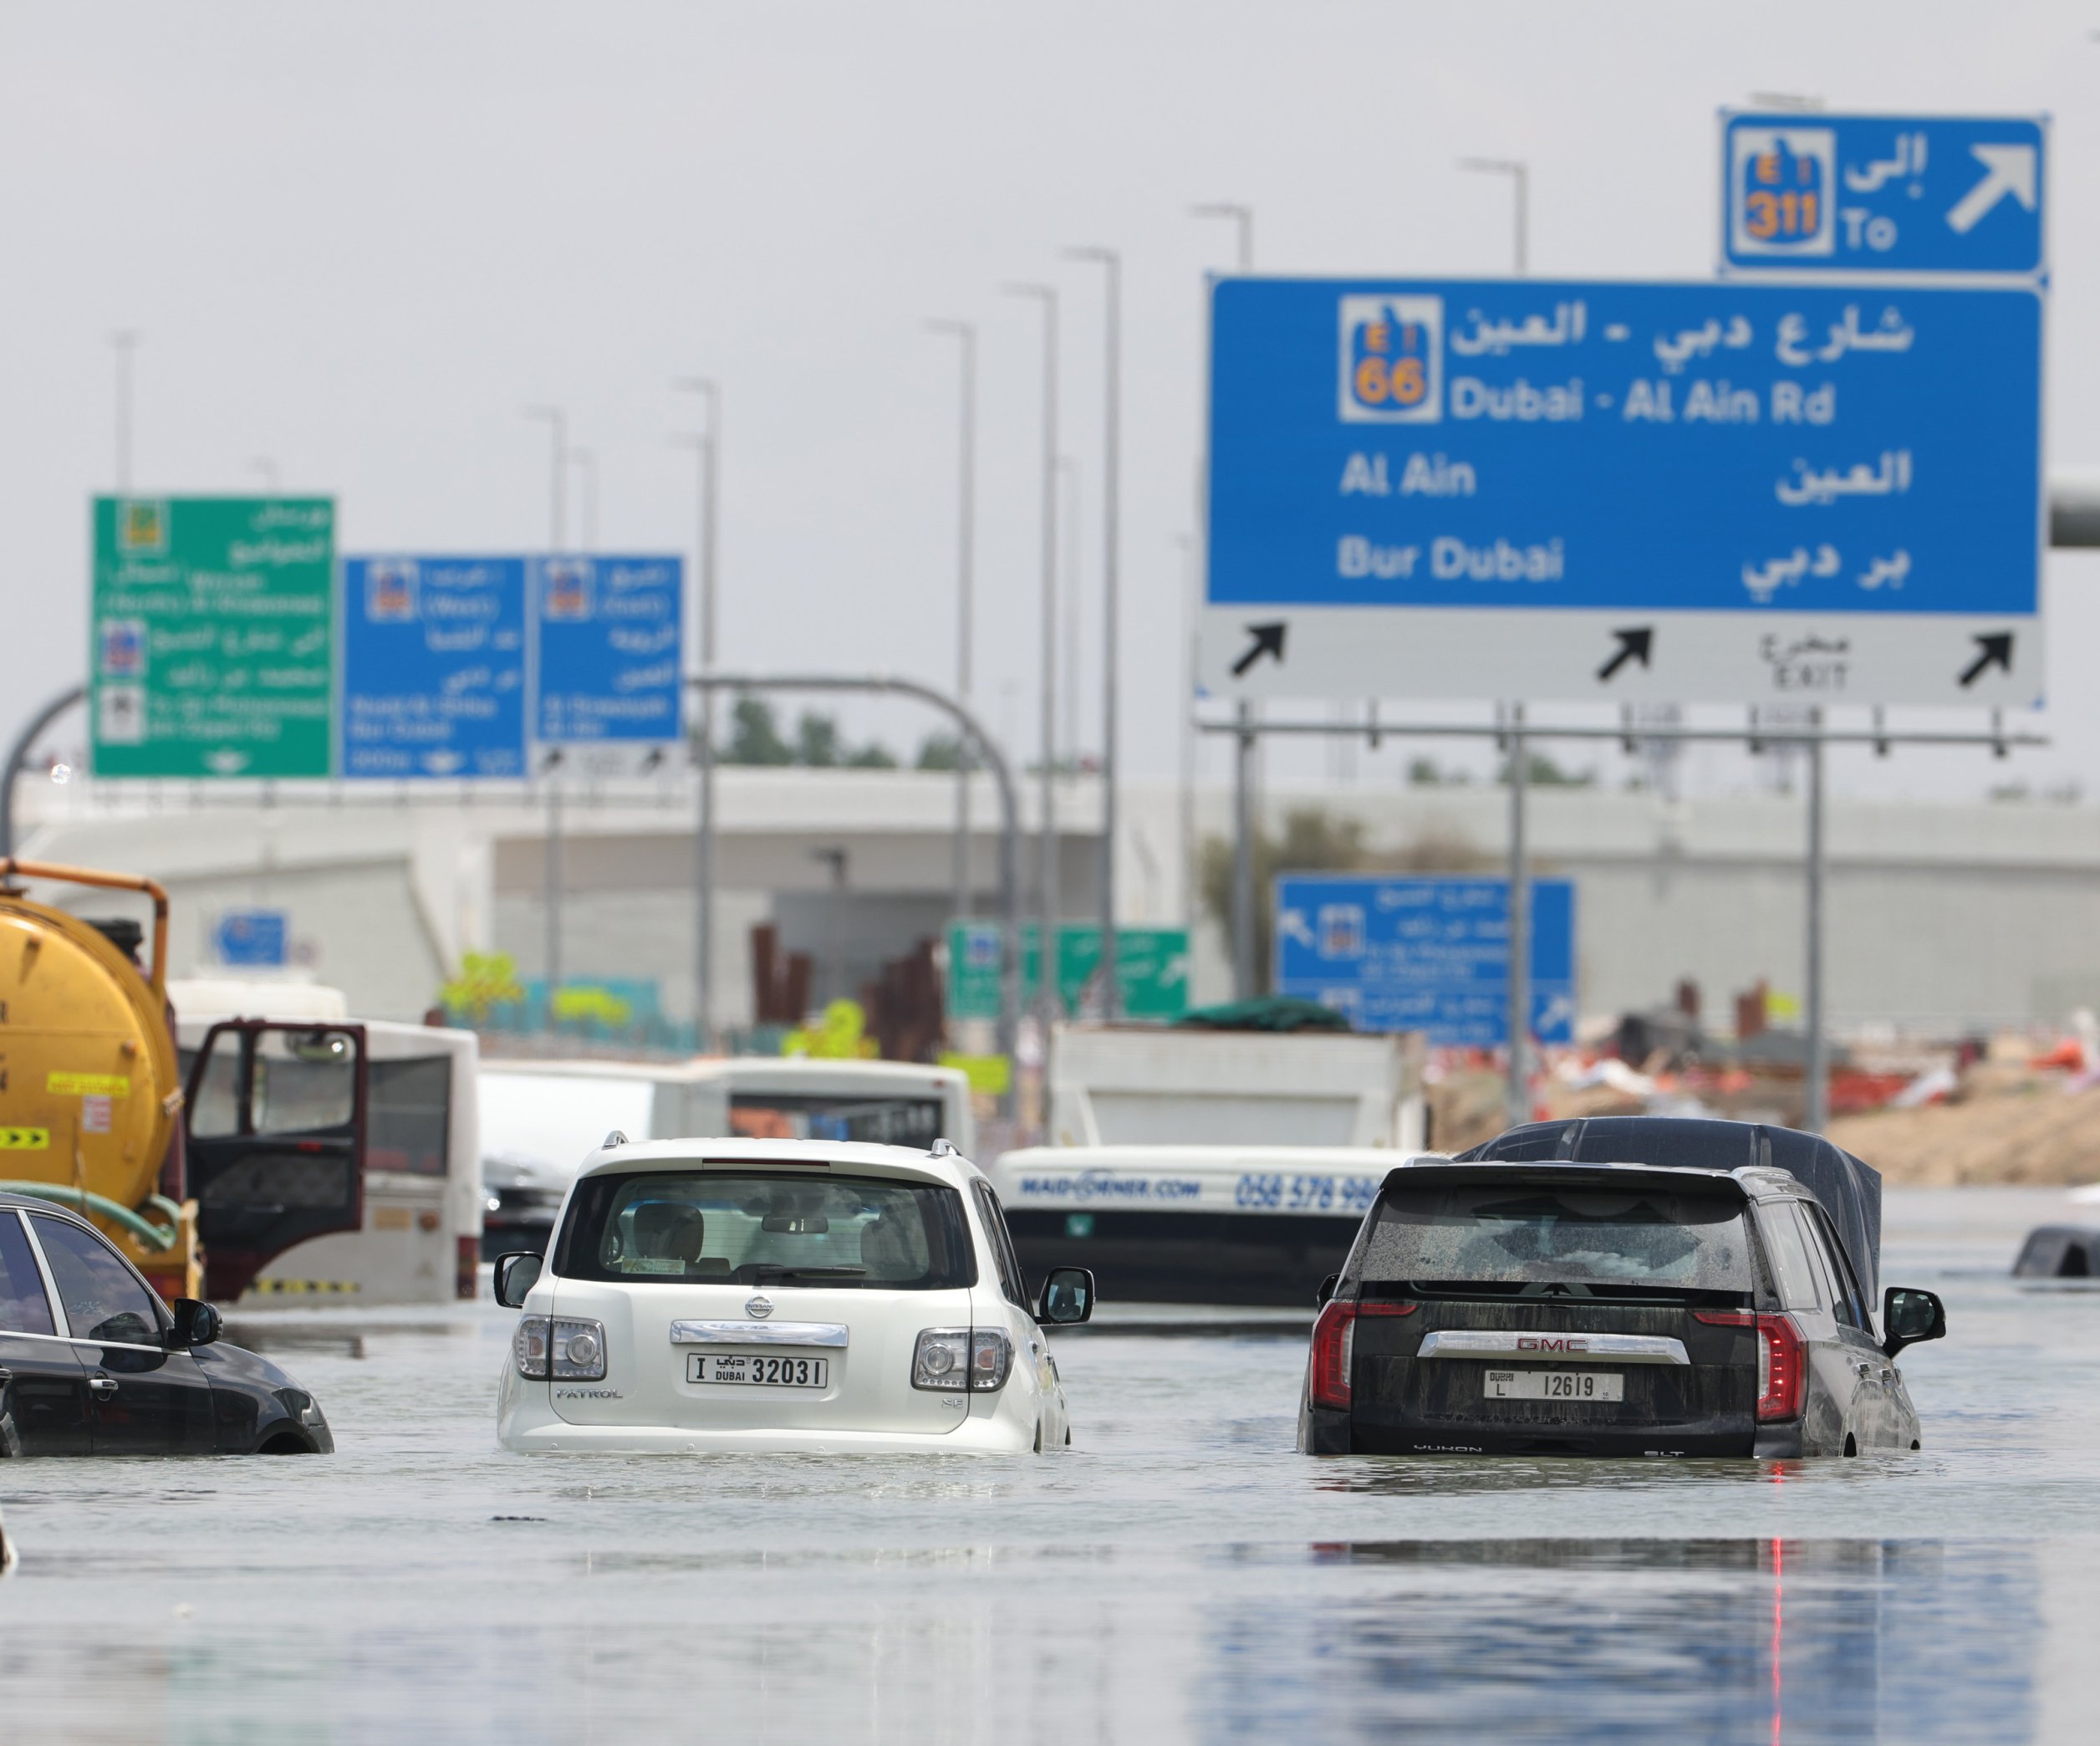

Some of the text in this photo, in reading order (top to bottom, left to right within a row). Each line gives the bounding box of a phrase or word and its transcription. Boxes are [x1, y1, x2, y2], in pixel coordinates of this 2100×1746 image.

[1756, 154, 1780, 184] E
[1845, 133, 1927, 199] إلى
[1746, 191, 1818, 239] 311
[1842, 208, 1898, 251] To
[1365, 323, 1389, 353] E
[1450, 300, 1586, 355] العين
[1654, 314, 1752, 375] دبي
[1776, 304, 1915, 367] شارع
[1356, 356, 1425, 404] 66
[1451, 377, 1583, 421] Dubai
[1623, 380, 1674, 421] Al
[1684, 380, 1758, 421] Ain
[1771, 381, 1836, 425] Rd
[1339, 452, 1476, 496] Al Ain
[1774, 450, 1911, 506] العين
[1338, 535, 1564, 581] Bur Dubai
[1742, 544, 1910, 603] بر دبي
[1773, 663, 1848, 690] EXIT
[1517, 1338, 1588, 1352] GMC
[716, 1358, 745, 1369] دبي
[716, 1371, 745, 1381] DUBAI
[752, 1358, 819, 1385] 32031
[557, 1389, 624, 1399] PATROL
[942, 1398, 963, 1408] SE
[1496, 1383, 1506, 1396] L
[1545, 1376, 1593, 1396] 12619
[1414, 1444, 1482, 1452] YUKON
